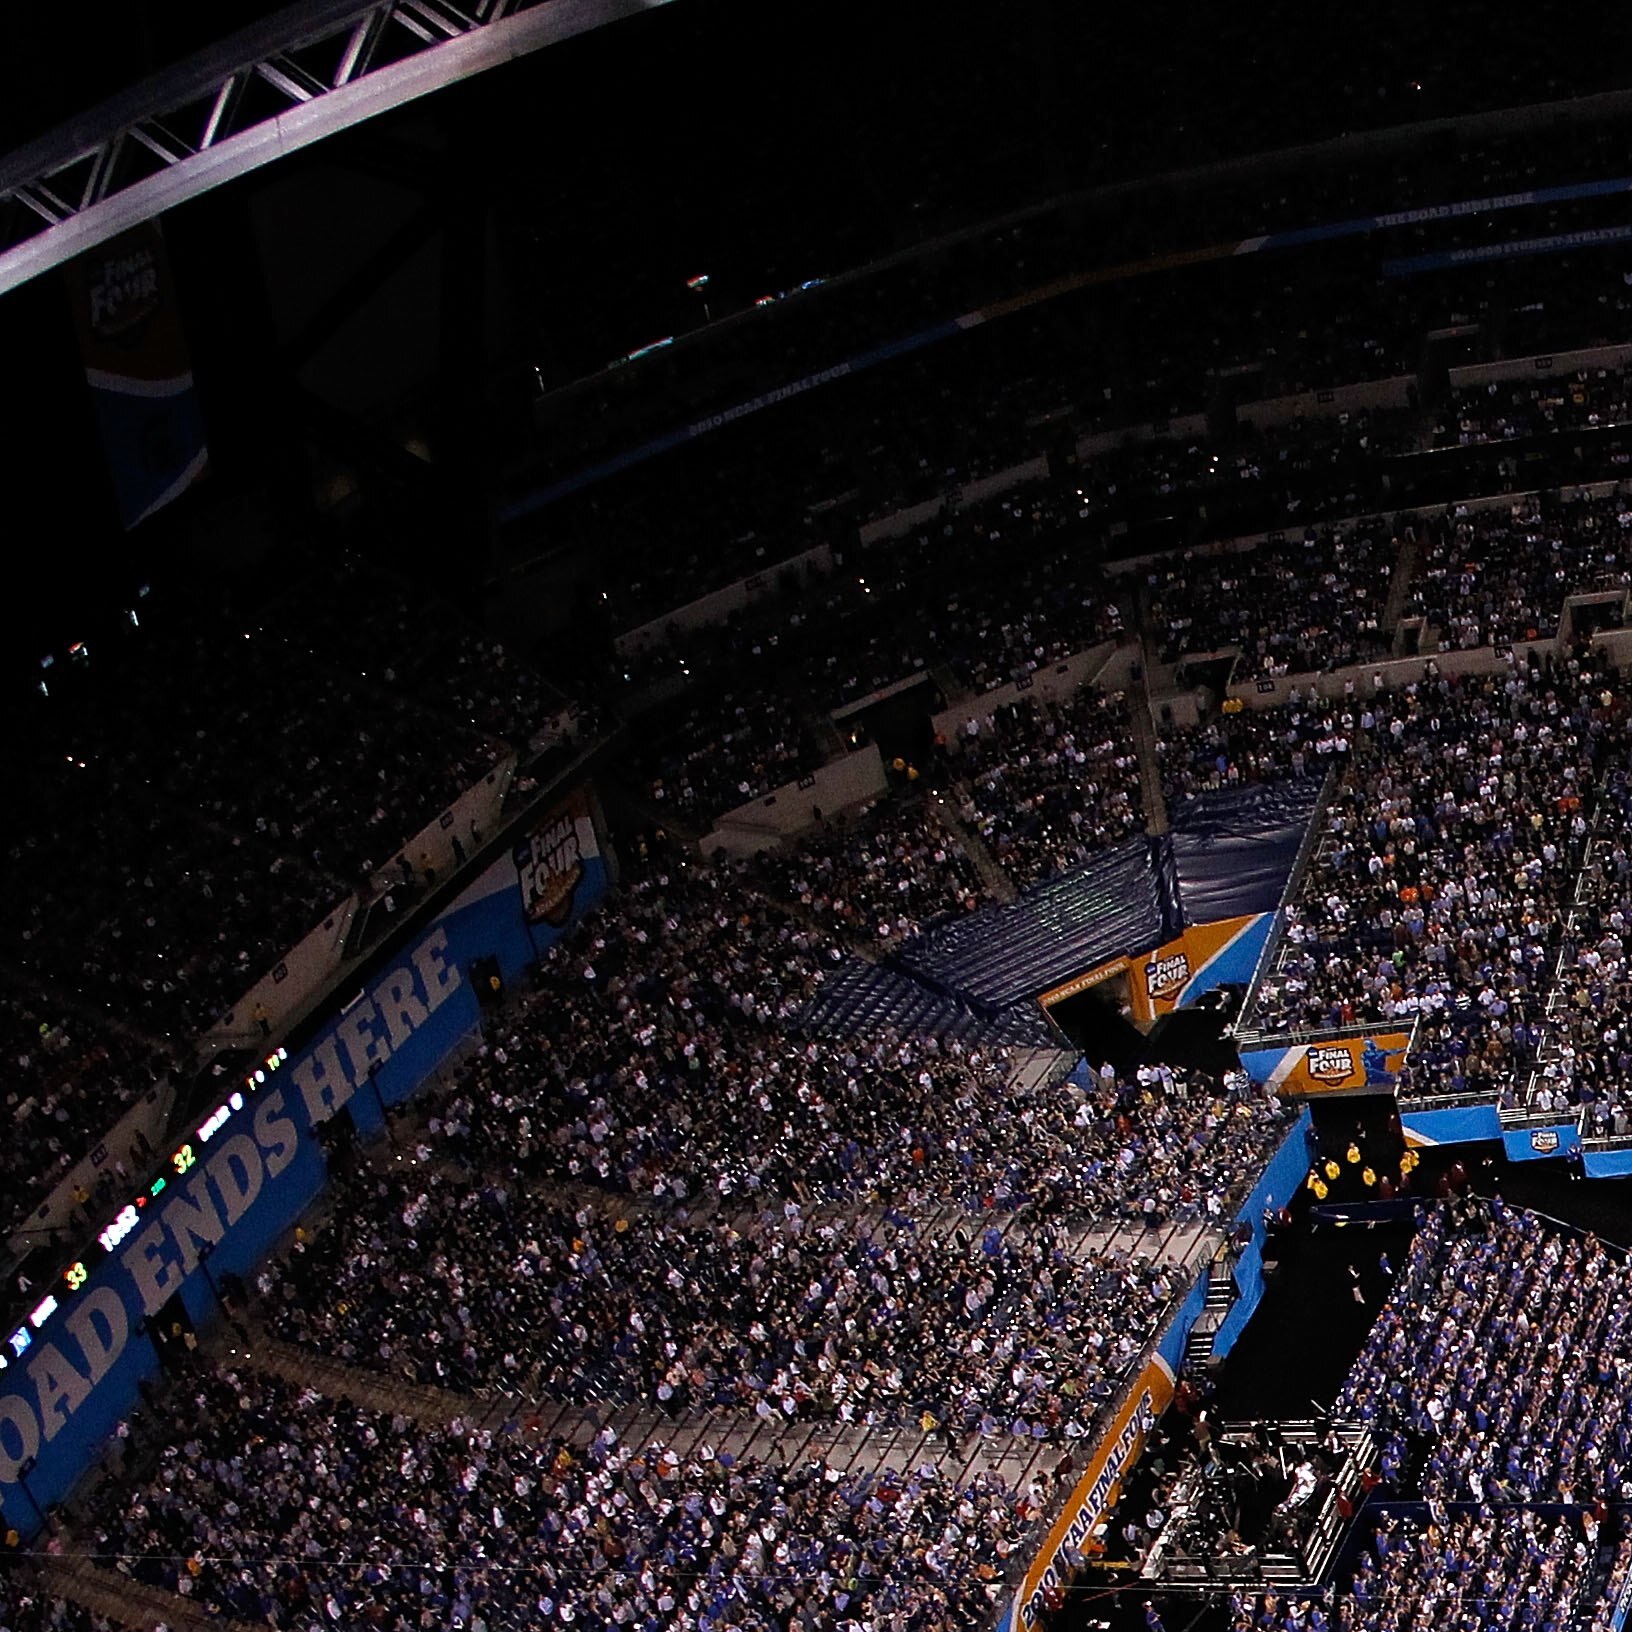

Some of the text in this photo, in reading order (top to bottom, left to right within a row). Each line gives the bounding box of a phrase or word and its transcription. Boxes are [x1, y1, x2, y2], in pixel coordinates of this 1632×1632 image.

[530, 815, 574, 866] FINAL
[519, 836, 579, 914] FOUR
[1147, 965, 1189, 994] FOUR
[1156, 954, 1186, 976] FINAL
[1308, 1058, 1352, 1074] FOUR
[1318, 1050, 1350, 1060] FINAL
[122, 1090, 299, 1317] ENDS
[292, 928, 463, 1127] HERE
[172, 1144, 196, 1174] 32
[63, 1262, 88, 1290] 33
[1085, 1441, 1132, 1513] FINAL
